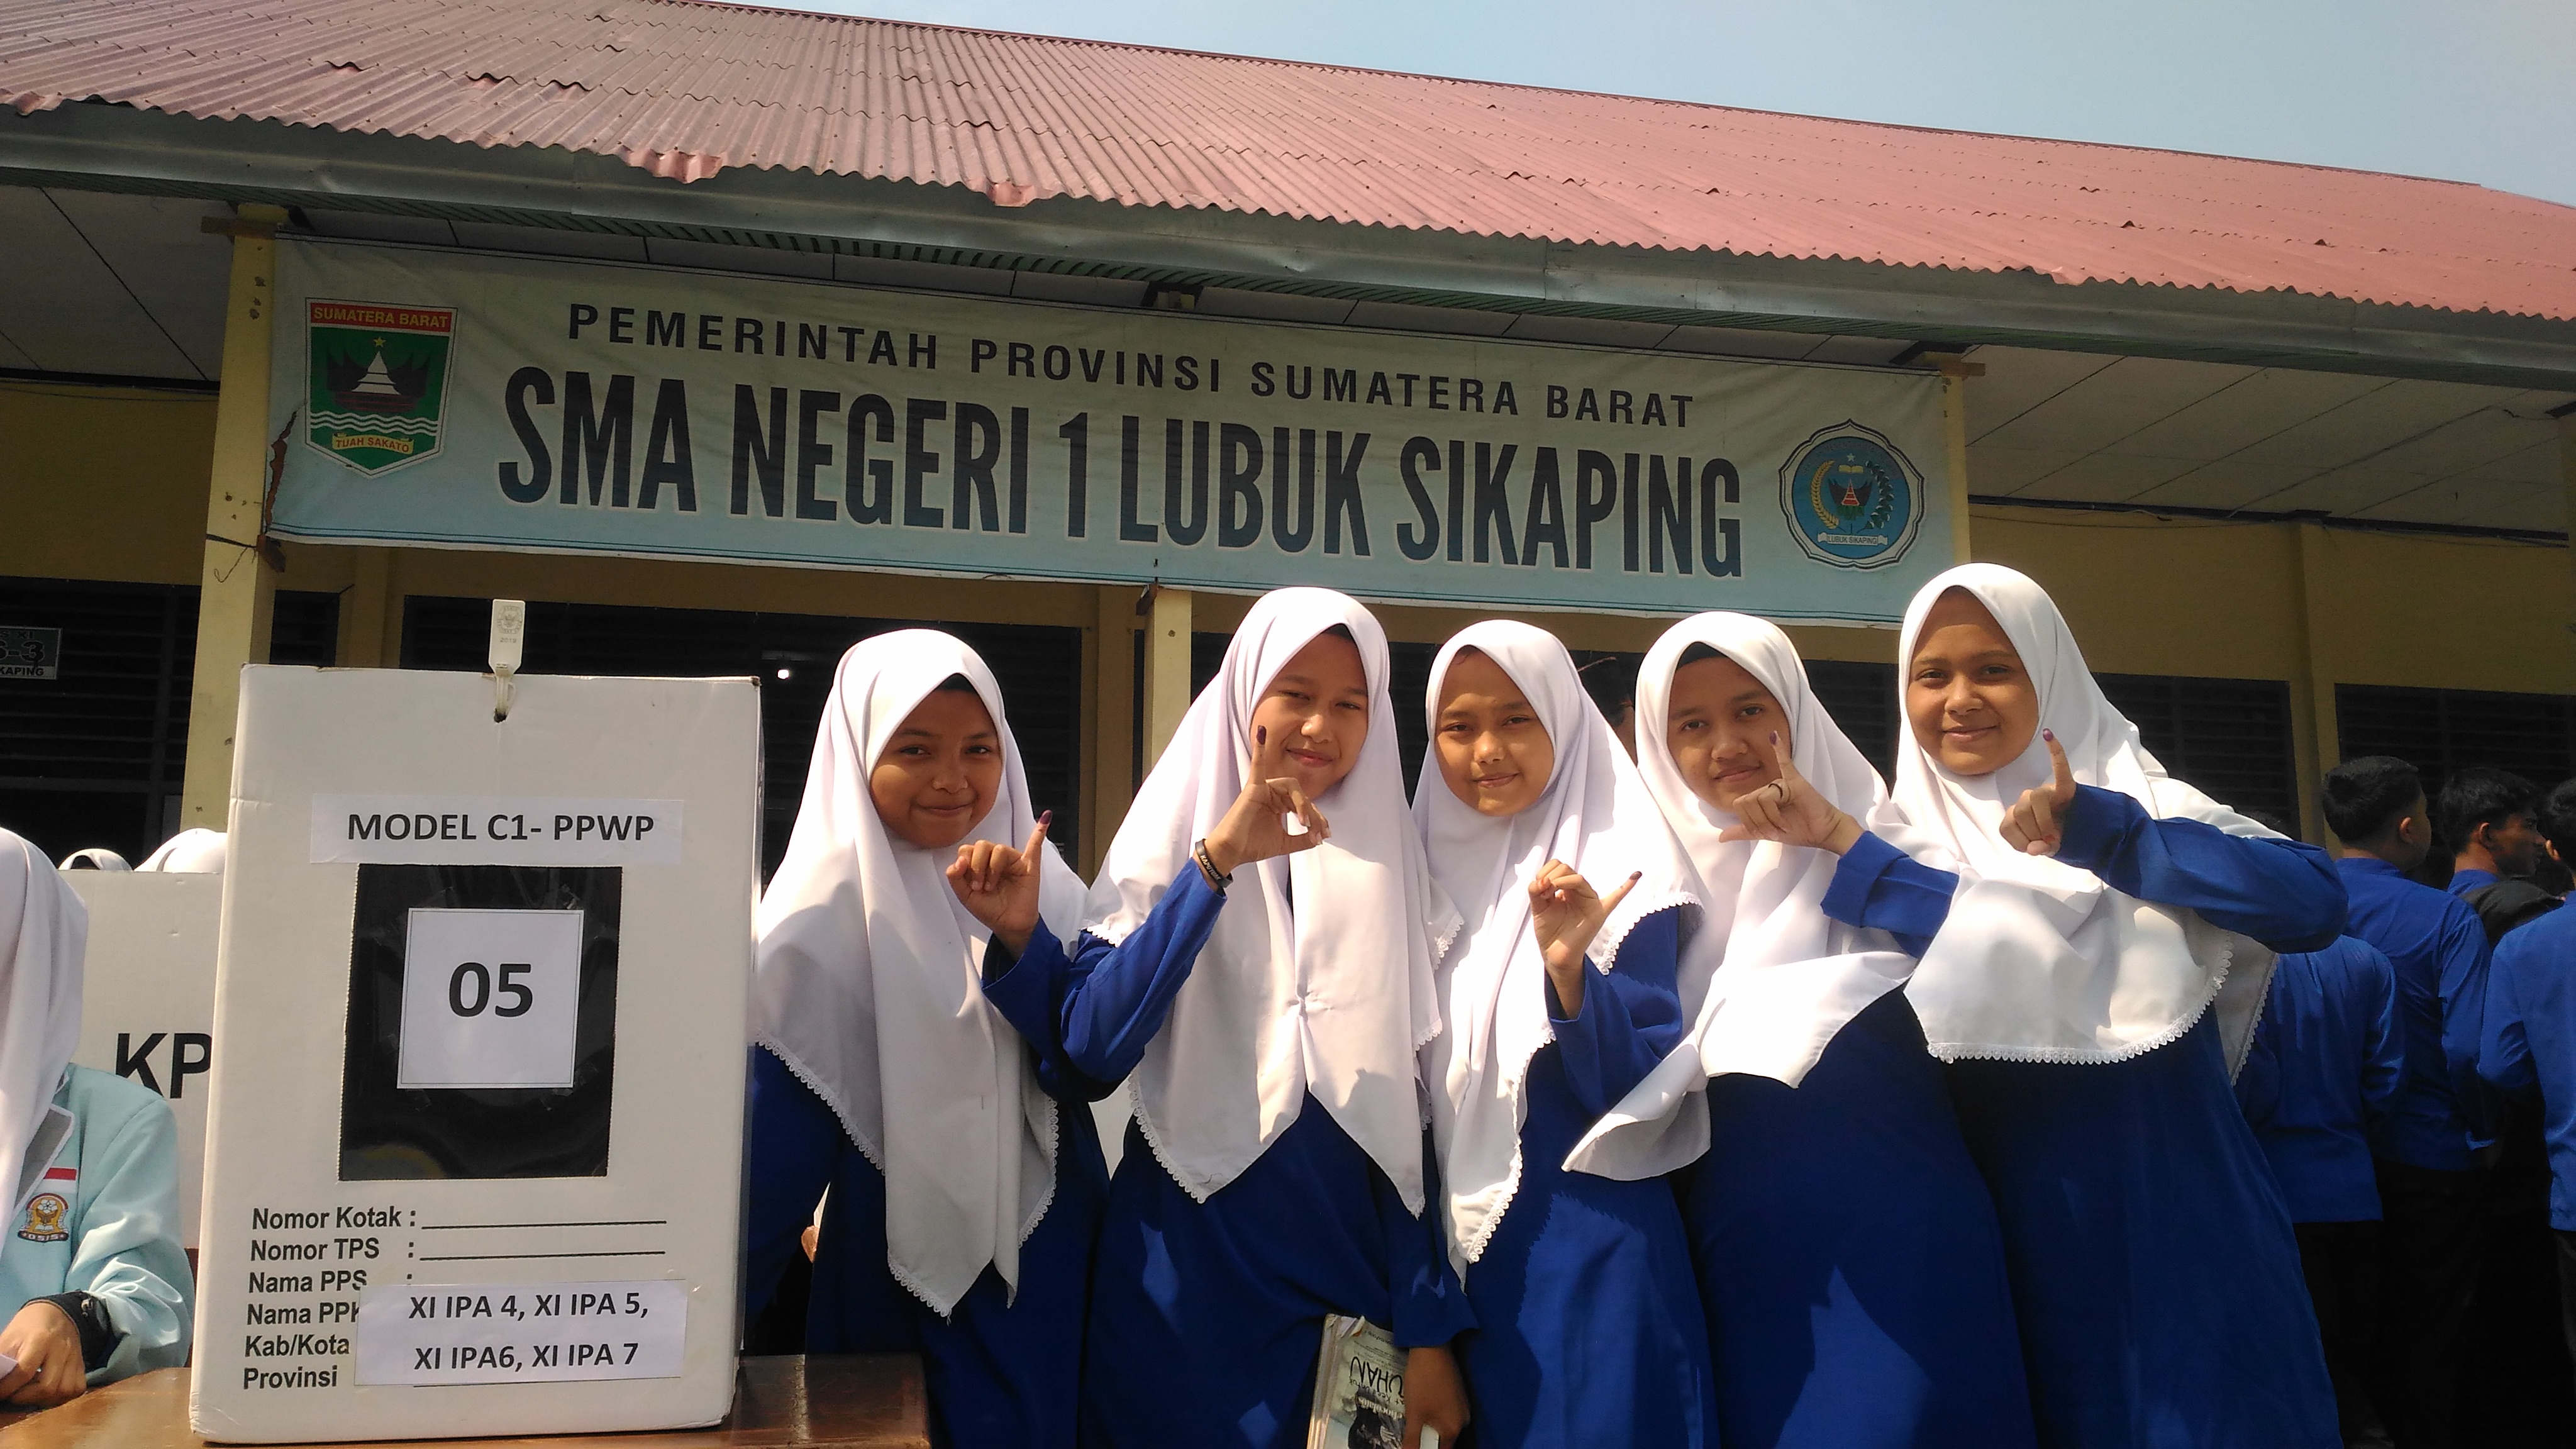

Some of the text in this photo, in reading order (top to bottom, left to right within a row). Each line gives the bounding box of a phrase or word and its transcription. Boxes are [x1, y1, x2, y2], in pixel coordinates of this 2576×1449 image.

[314, 306, 448, 328] SUMATERA BARAT
[569, 304, 1692, 427] PEMERINTAH PROVINSI SUMATERA BARAT
[336, 437, 409, 453] TUAH SAKATO
[499, 367, 1741, 577] SMA NEGERI 1 LUBUK SIKAPING
[1828, 535, 1877, 545] LUBUK SIKAPING
[348, 814, 653, 840] MODEL C1- PPWP
[450, 962, 533, 1017] 05
[253, 1208, 330, 1230] Nomor
[336, 1206, 401, 1228] Kotak
[251, 1240, 328, 1261] Nomor
[334, 1238, 379, 1259] TPS
[249, 1270, 367, 1293] Nama PPS
[247, 1304, 311, 1324] Nama
[409, 1293, 647, 1321] XI IPA 4, XI IPA 5,
[245, 1335, 349, 1357] Kab/Kota
[414, 1343, 638, 1372] XI IPA6, XI IPA 7
[244, 1365, 337, 1389] Provinsi
[1350, 1357, 1404, 1397] UHAN
